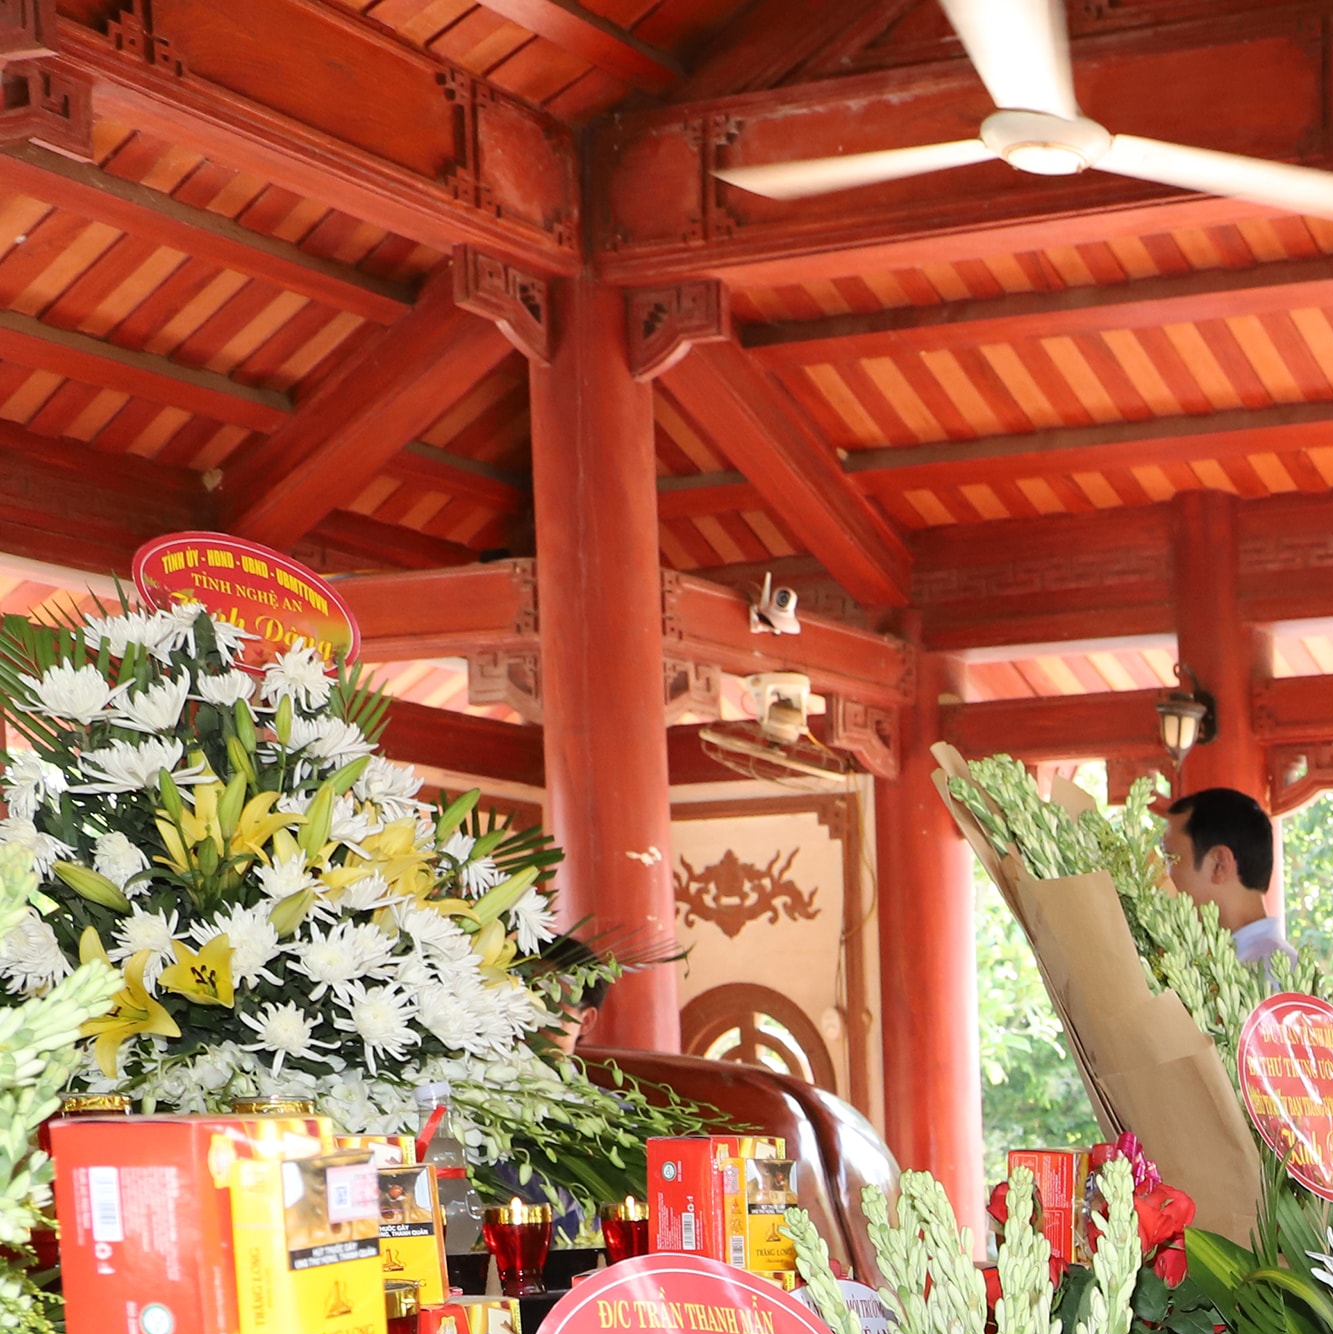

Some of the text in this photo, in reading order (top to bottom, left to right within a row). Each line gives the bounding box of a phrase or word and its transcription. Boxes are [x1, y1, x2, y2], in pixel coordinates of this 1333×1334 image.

[236, 584, 278, 608] NGHỆ
[283, 596, 303, 613] AN
[597, 1300, 631, 1328] Đ/C
[633, 1286, 685, 1329] TRẦN
[684, 1303, 739, 1334] THANH
